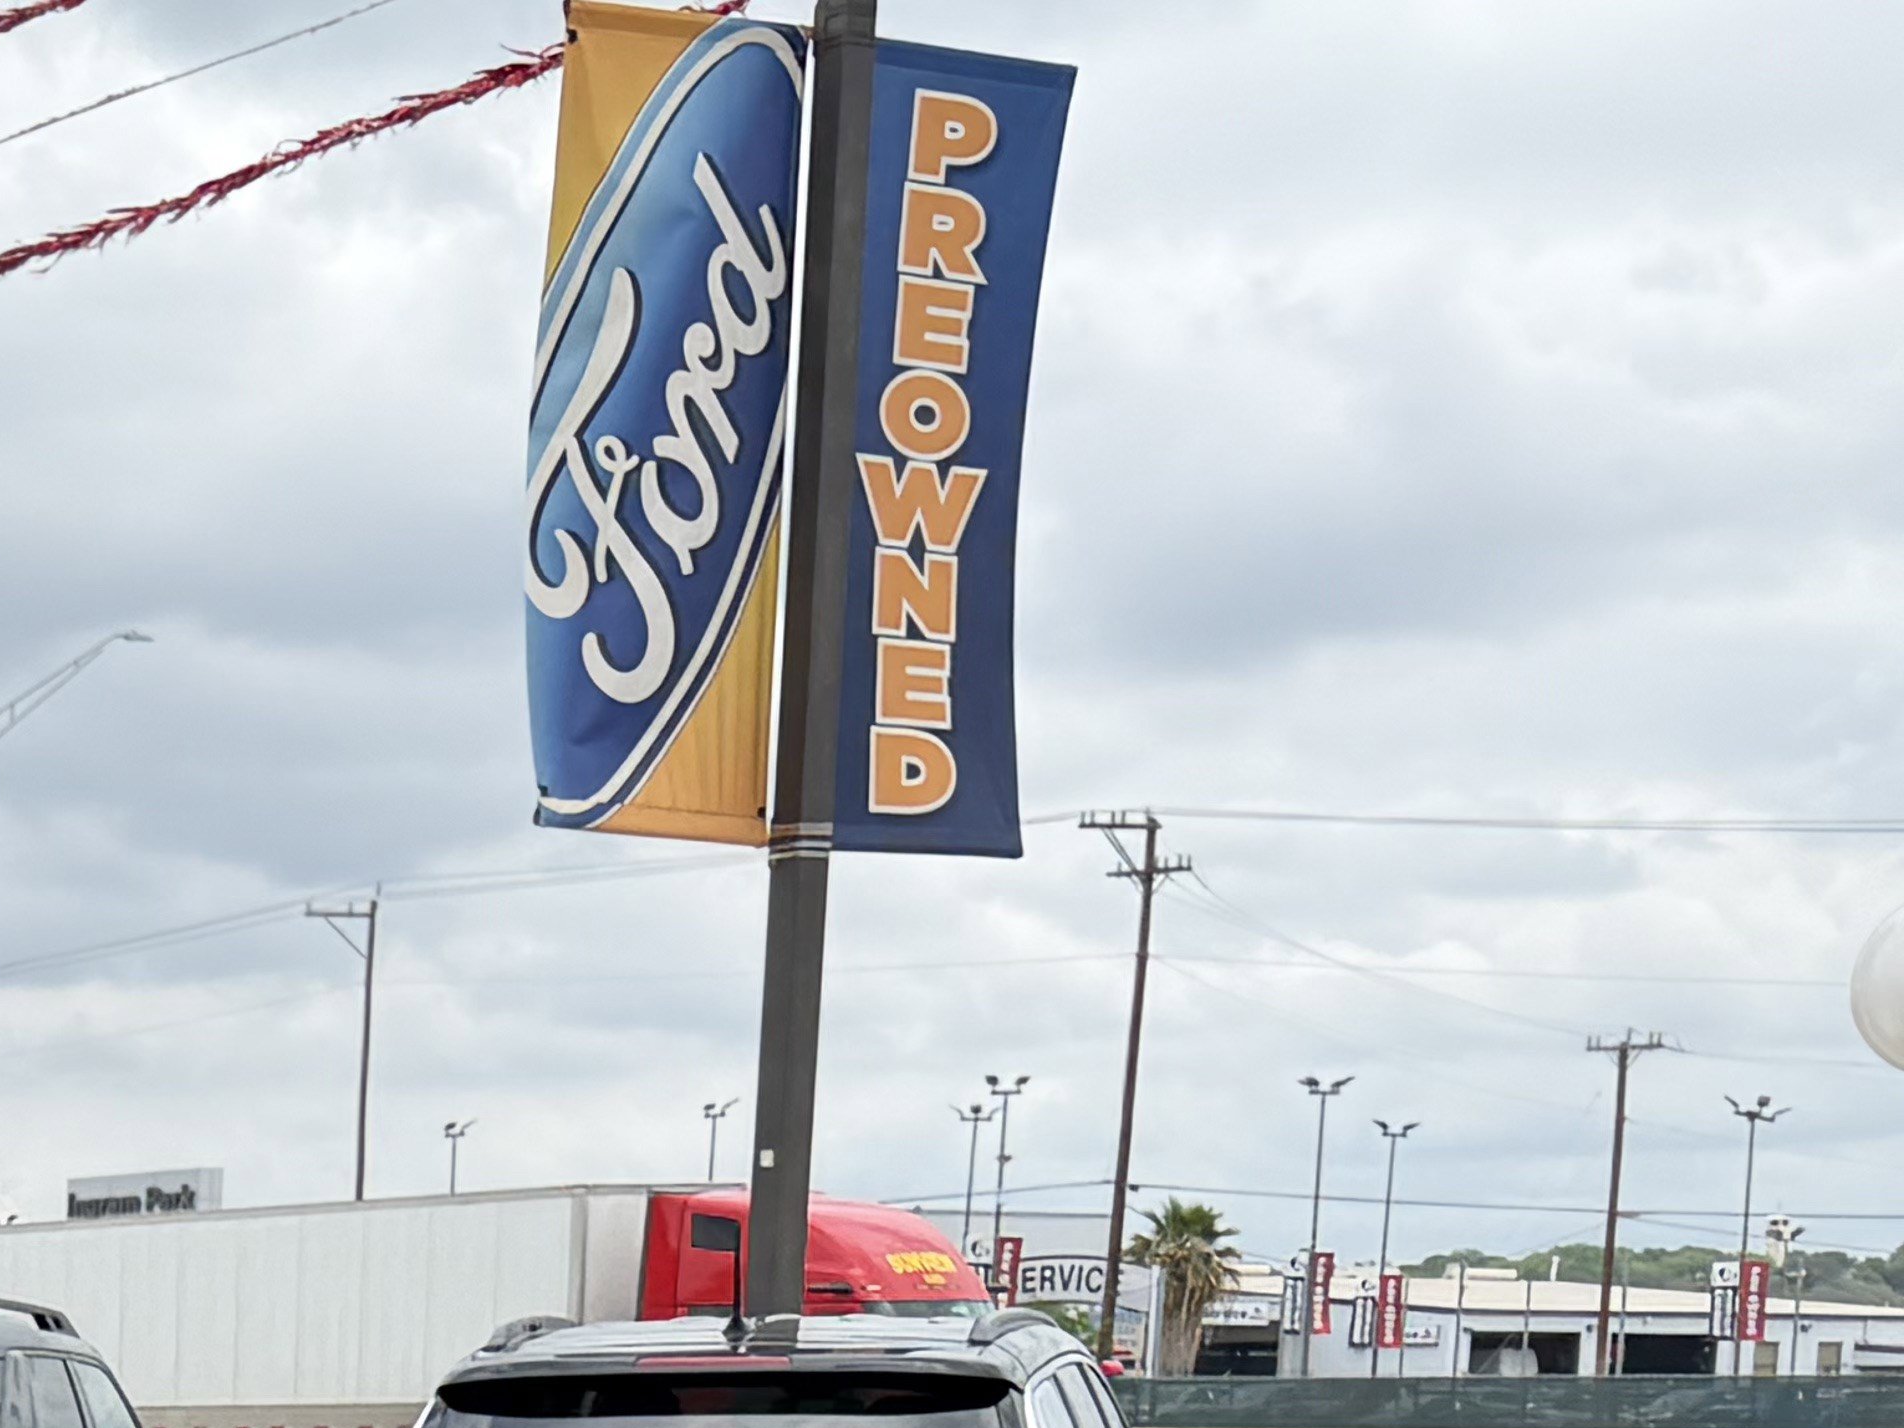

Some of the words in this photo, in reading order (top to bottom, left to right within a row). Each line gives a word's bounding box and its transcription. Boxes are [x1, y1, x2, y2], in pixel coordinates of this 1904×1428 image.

[524, 151, 788, 704] Ford
[854, 86, 999, 815] PREOWNED
[1021, 1263, 1122, 1293] ERVIC
